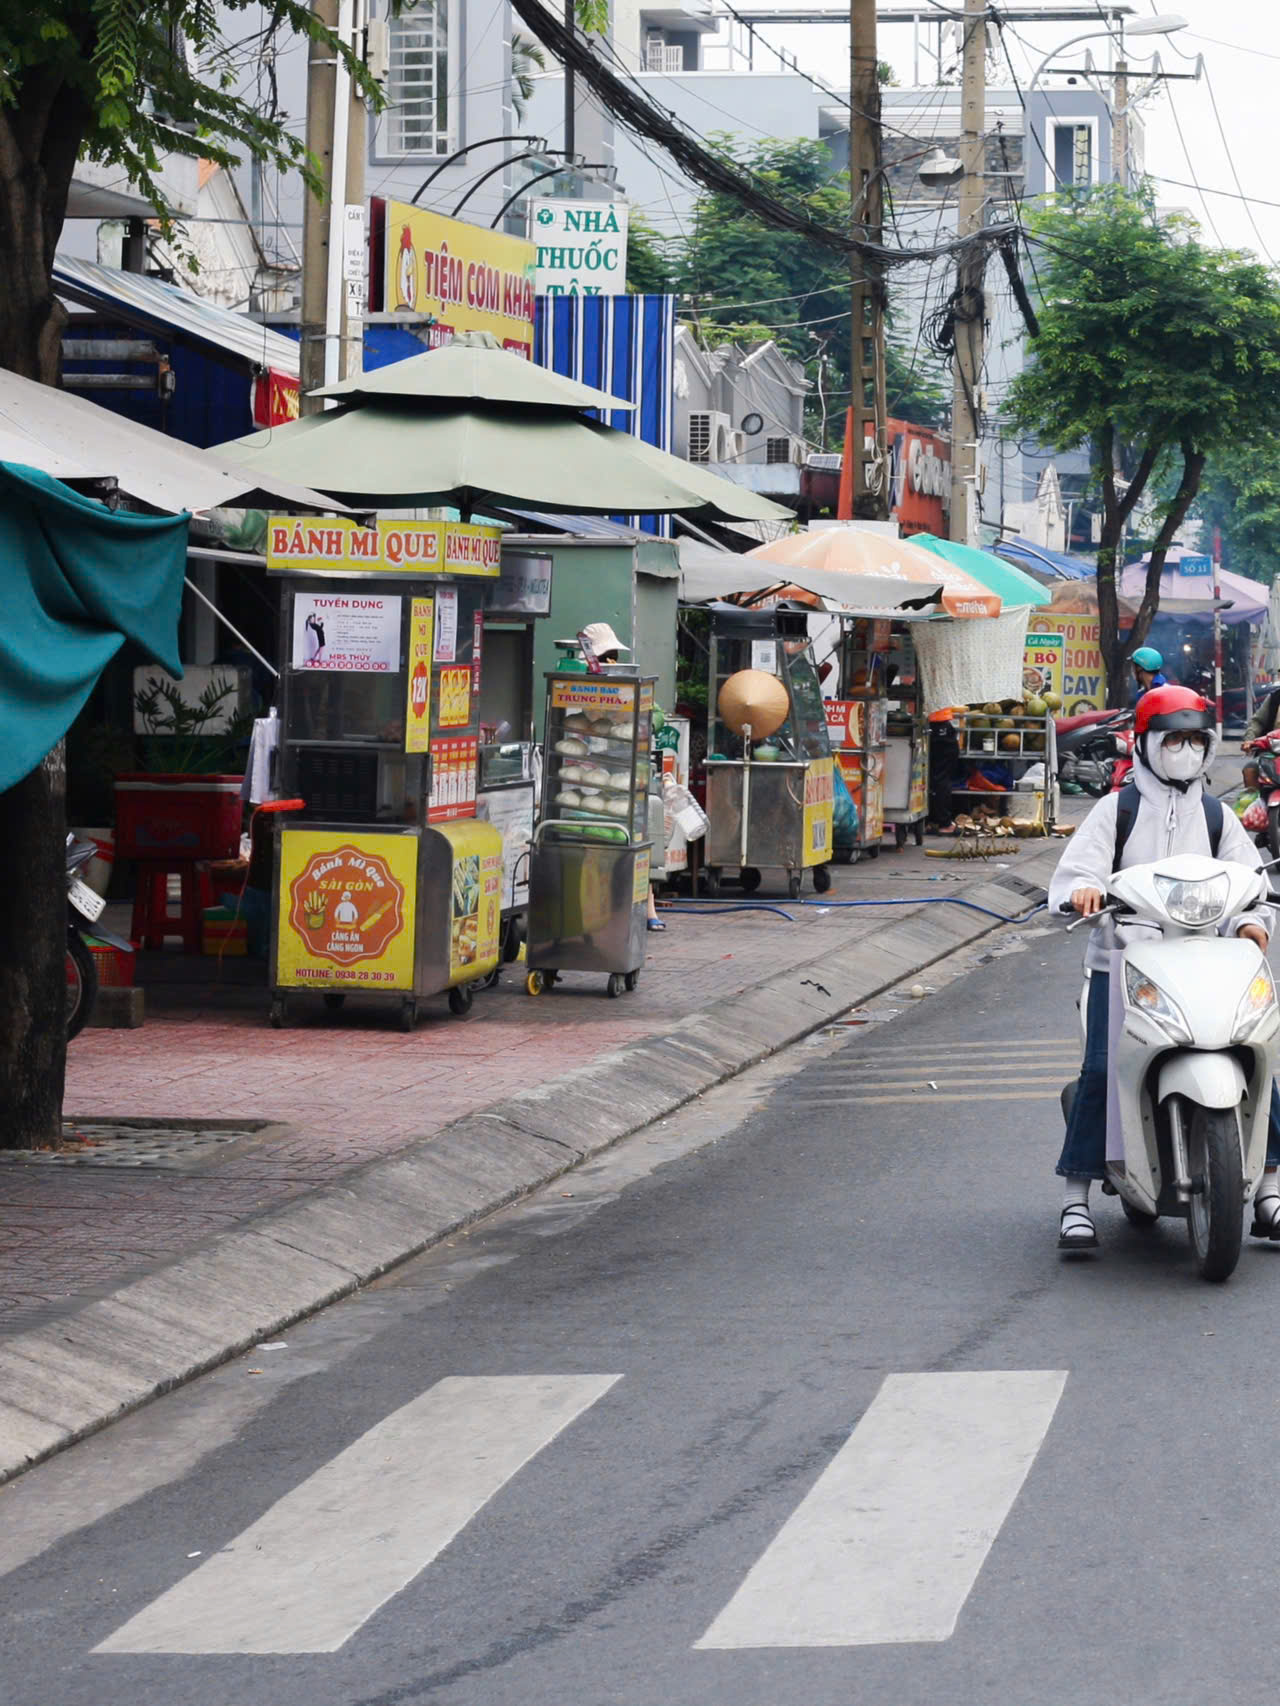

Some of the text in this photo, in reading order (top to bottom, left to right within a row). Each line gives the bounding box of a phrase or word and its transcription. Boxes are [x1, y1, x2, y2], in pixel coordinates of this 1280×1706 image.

[563, 204, 620, 232] NHÀ
[535, 239, 618, 270] THUỐC
[425, 240, 463, 315] TIỆM
[467, 261, 500, 313] CƠM
[273, 522, 343, 556] BÁNH
[386, 532, 437, 563] QUE
[446, 529, 469, 562] BÁNH
[482, 540, 499, 567] QUE
[313, 597, 384, 610] TUYỂN DỤNG
[1034, 650, 1057, 664] BÒ
[412, 676, 428, 703] 12K
[1064, 675, 1100, 696] CAY
[312, 857, 385, 888] Bánh Mì Que
[319, 878, 374, 892] SÀI GÒN
[295, 968, 395, 981] HOTLINE: 0938 28 30 39
